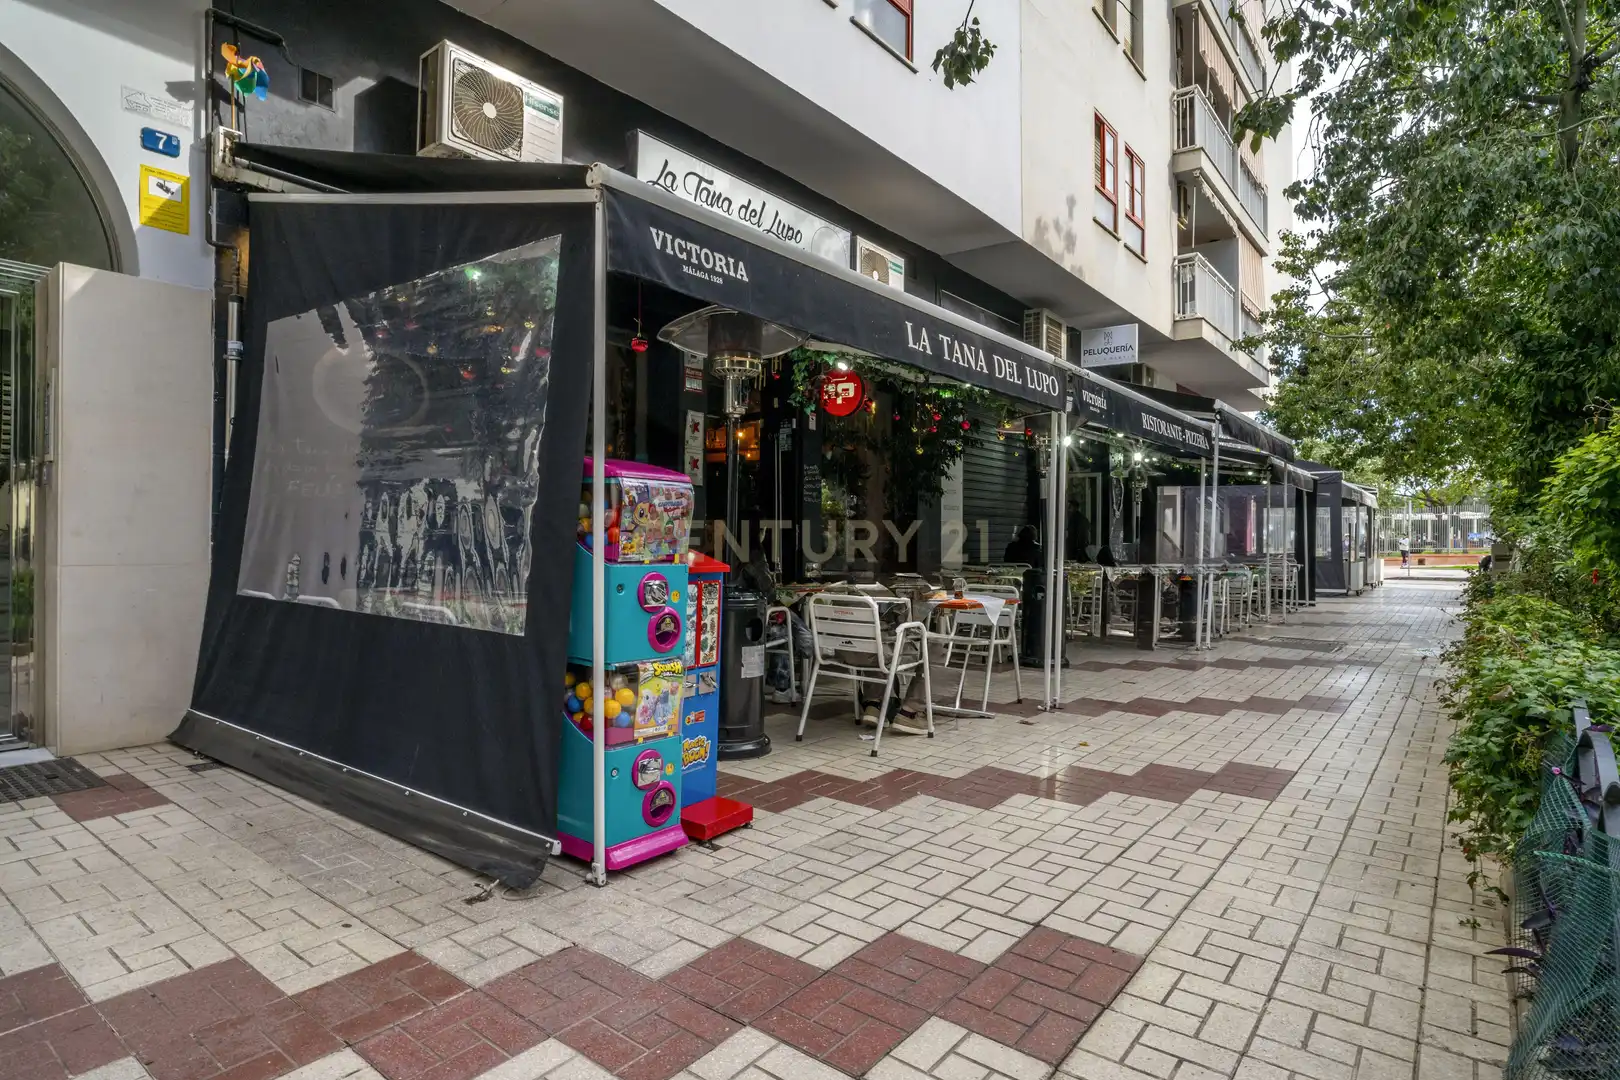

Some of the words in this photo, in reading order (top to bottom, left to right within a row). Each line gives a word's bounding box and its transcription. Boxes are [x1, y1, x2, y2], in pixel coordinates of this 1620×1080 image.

[525, 94, 560, 117] Hisense
[155, 132, 167, 150] 7
[646, 159, 679, 195] La
[683, 171, 735, 217] Tana
[738, 198, 766, 229] del
[762, 210, 803, 244] Lupo
[650, 226, 749, 282] VICTORIA
[710, 274, 724, 285] 1928
[905, 320, 933, 355] LA
[938, 333, 989, 374] TANA
[992, 354, 1023, 385] DEL
[1025, 366, 1059, 397] LUPO
[1083, 343, 1134, 357] PELUQUERÍA
[1141, 412, 1183, 441] RISTORANTE
